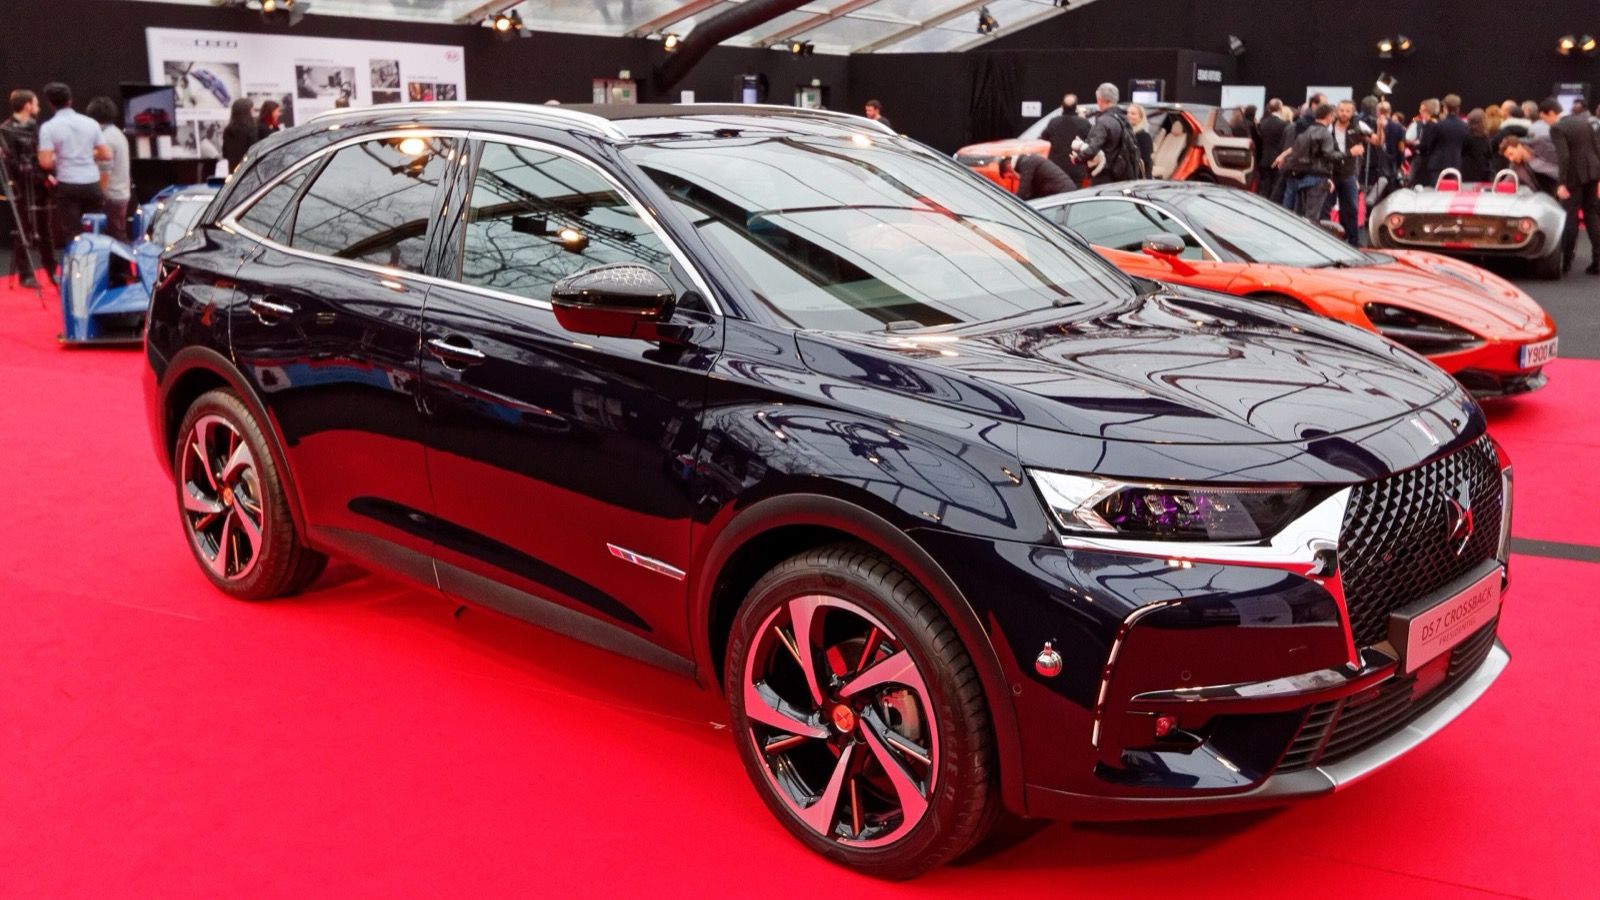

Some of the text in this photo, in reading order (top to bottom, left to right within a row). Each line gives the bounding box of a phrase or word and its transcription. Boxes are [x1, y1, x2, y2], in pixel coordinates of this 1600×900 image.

[1527, 345, 1548, 363] Y900
[1422, 586, 1492, 641] DS 7 CROSSBACK
